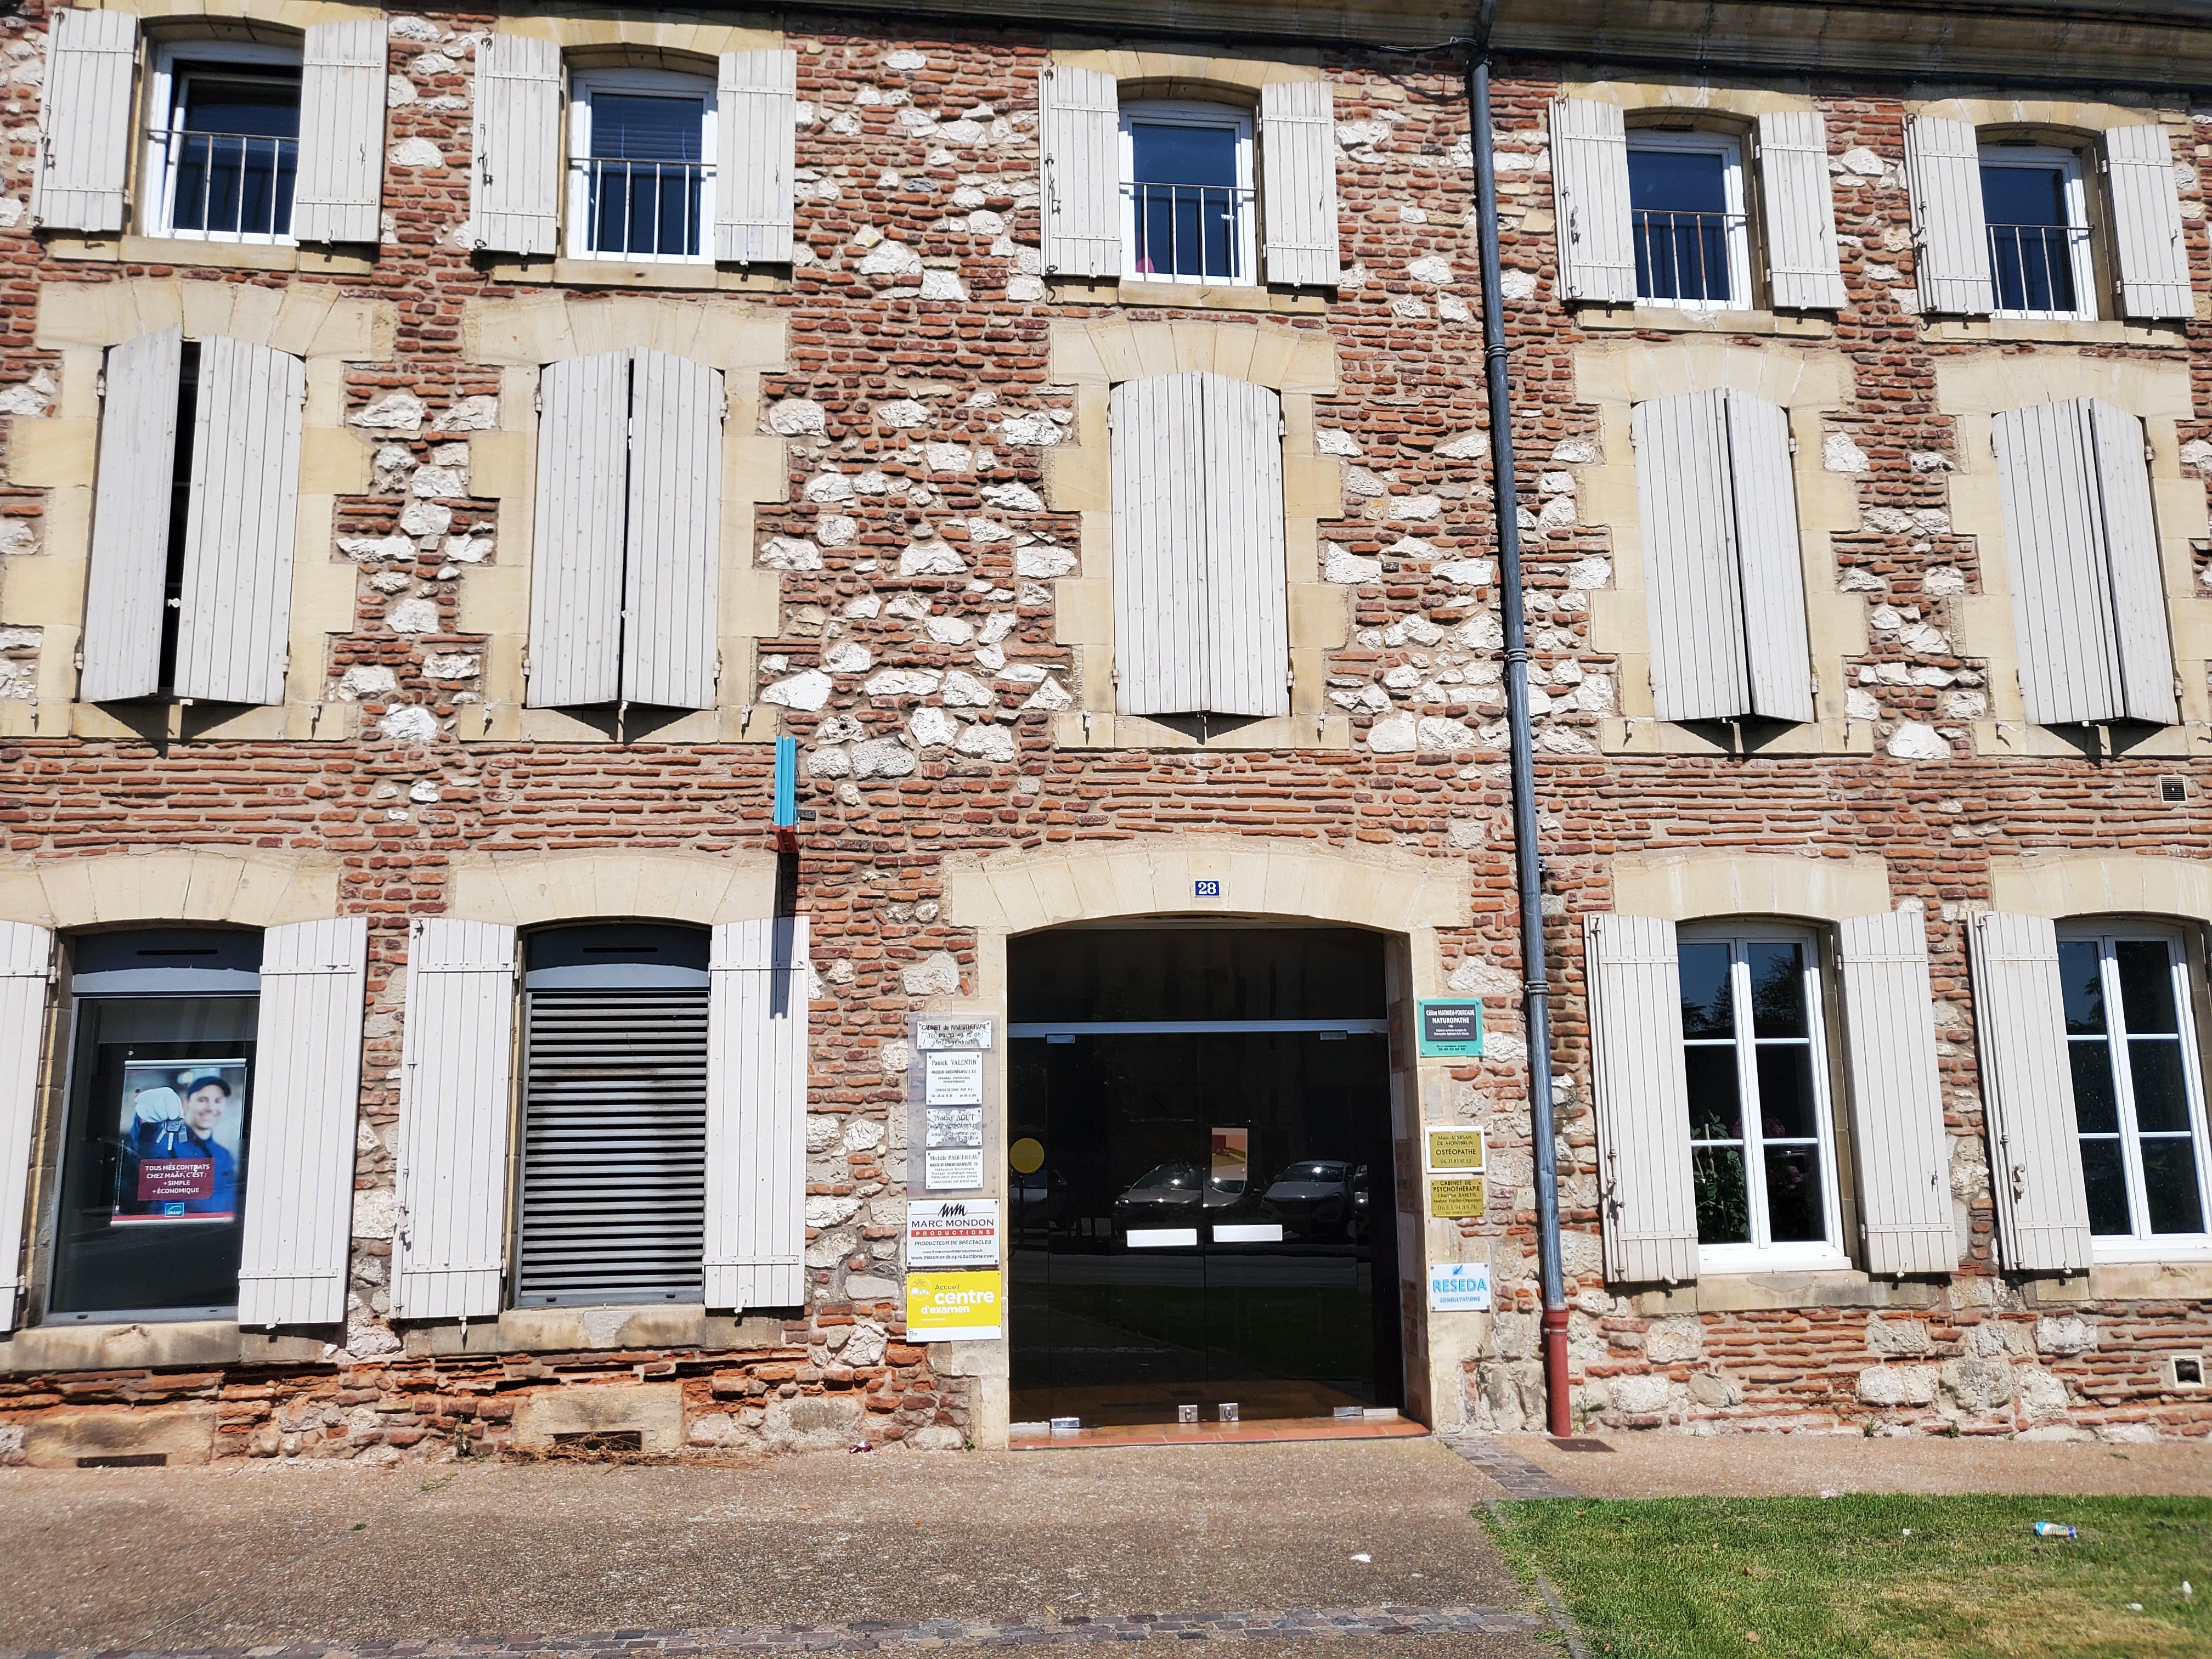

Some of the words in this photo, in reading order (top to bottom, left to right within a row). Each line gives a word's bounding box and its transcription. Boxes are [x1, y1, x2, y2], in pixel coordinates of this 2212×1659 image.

[1198, 882, 1216, 894] 28
[1433, 1278, 1488, 1293] RESEDA
[934, 1289, 995, 1304] centre
[921, 1305, 970, 1314] d'examen
